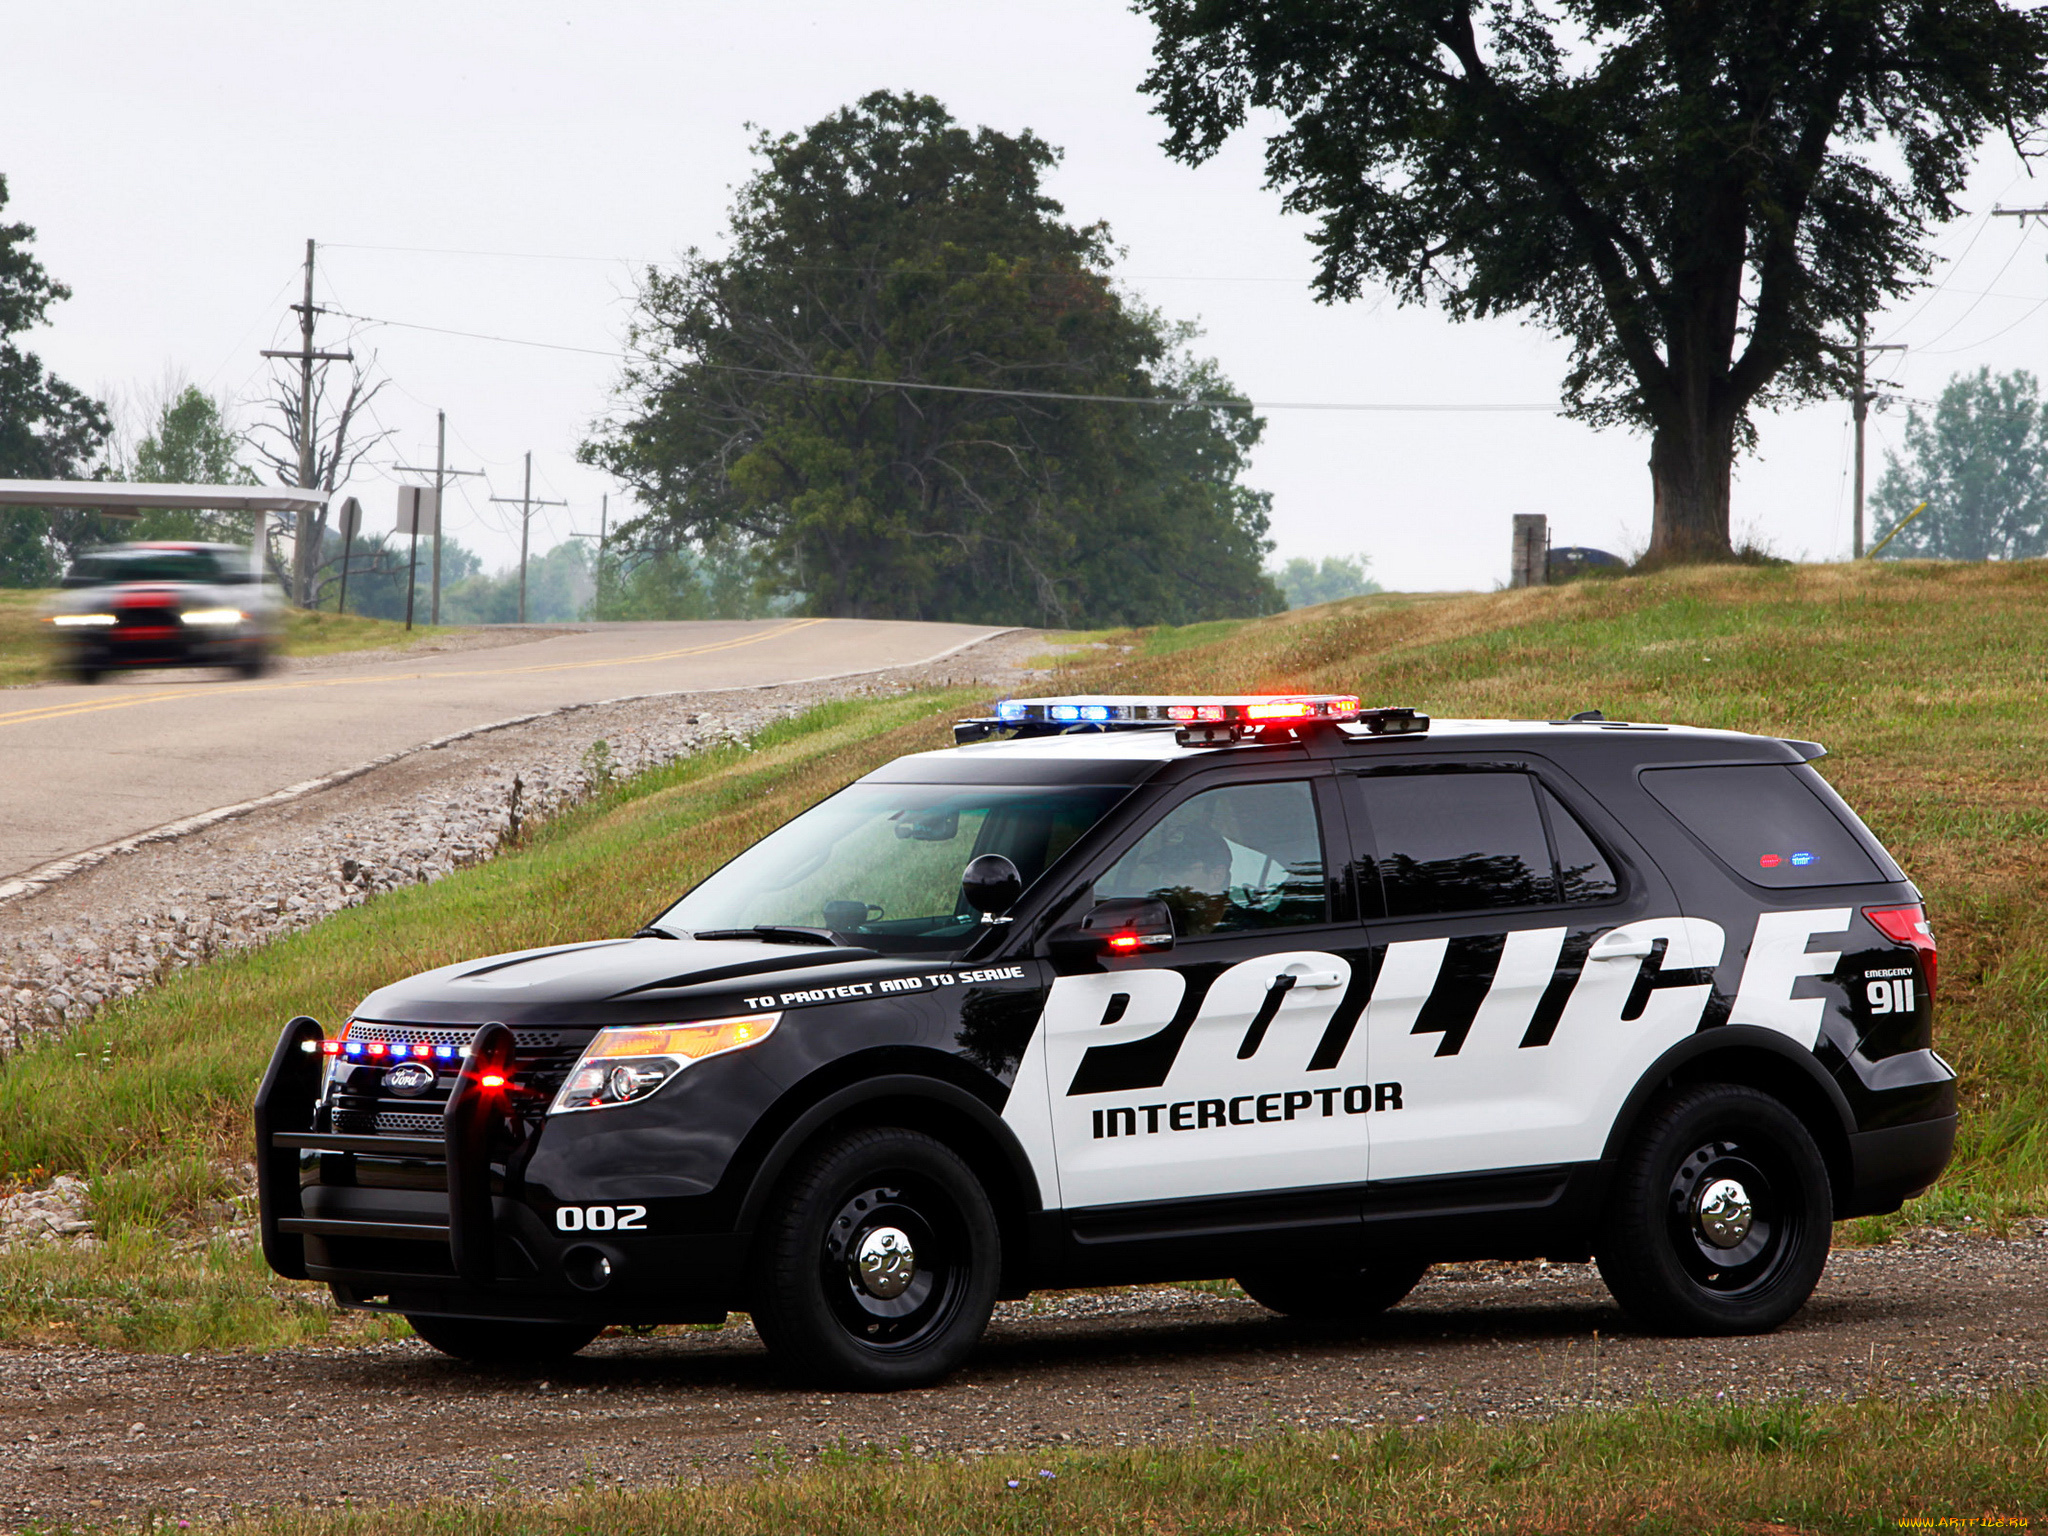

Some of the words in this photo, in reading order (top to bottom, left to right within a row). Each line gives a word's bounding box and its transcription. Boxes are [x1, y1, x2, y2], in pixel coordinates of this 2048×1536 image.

[743, 995, 776, 1009] TO
[779, 982, 873, 1005] PROTECT
[879, 976, 923, 993] AND
[925, 973, 955, 987] TO
[958, 966, 1025, 984] SERVE
[1865, 968, 1912, 978] EMERGENCY
[1003, 907, 1853, 1110] POLICE
[1867, 980, 1914, 1014] 911
[391, 1067, 419, 1086] Ford
[1092, 1081, 1404, 1139] INTERCEPTOR
[556, 1204, 648, 1232] 002
